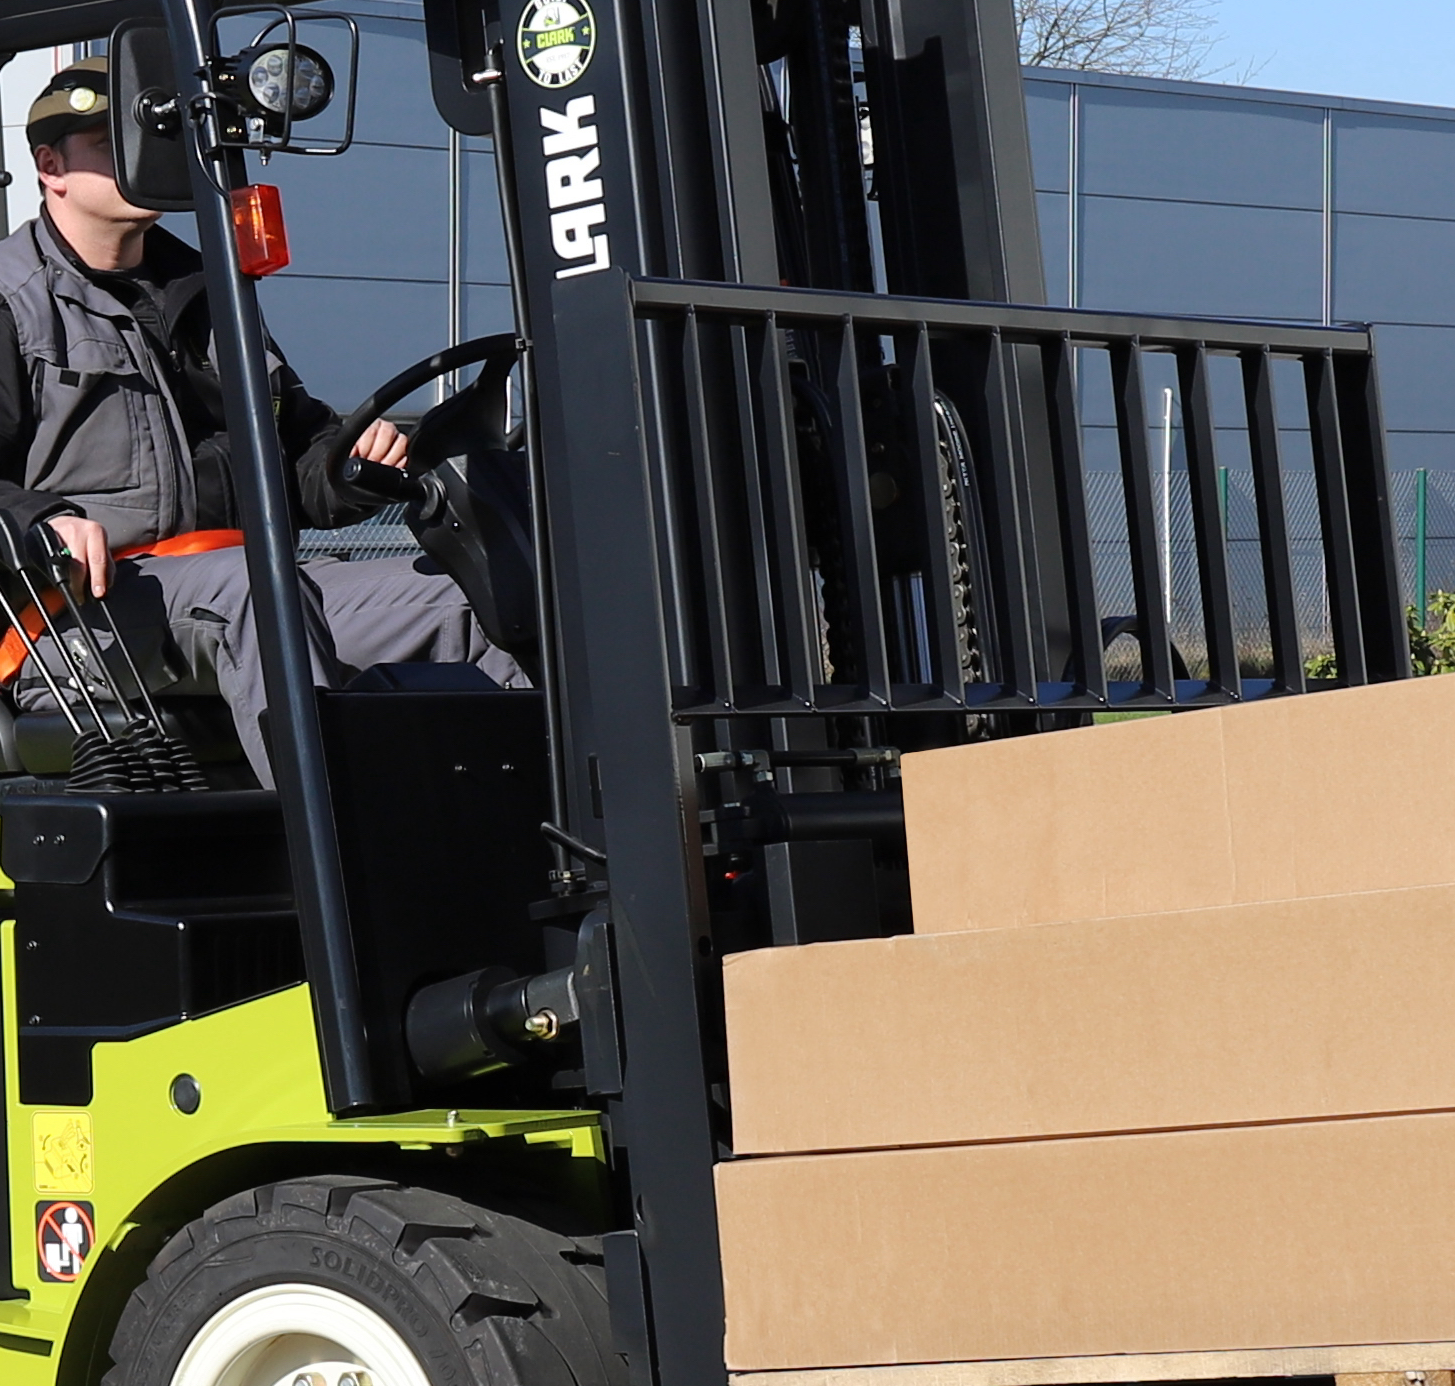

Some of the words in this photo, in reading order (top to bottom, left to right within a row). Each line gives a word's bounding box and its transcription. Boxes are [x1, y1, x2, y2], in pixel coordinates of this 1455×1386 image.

[536, 27, 575, 49] CLARK
[538, 68, 552, 85] TO
[558, 58, 584, 85] LAST
[539, 94, 610, 280] LARK
[309, 1246, 429, 1338] SOLIDPRO
